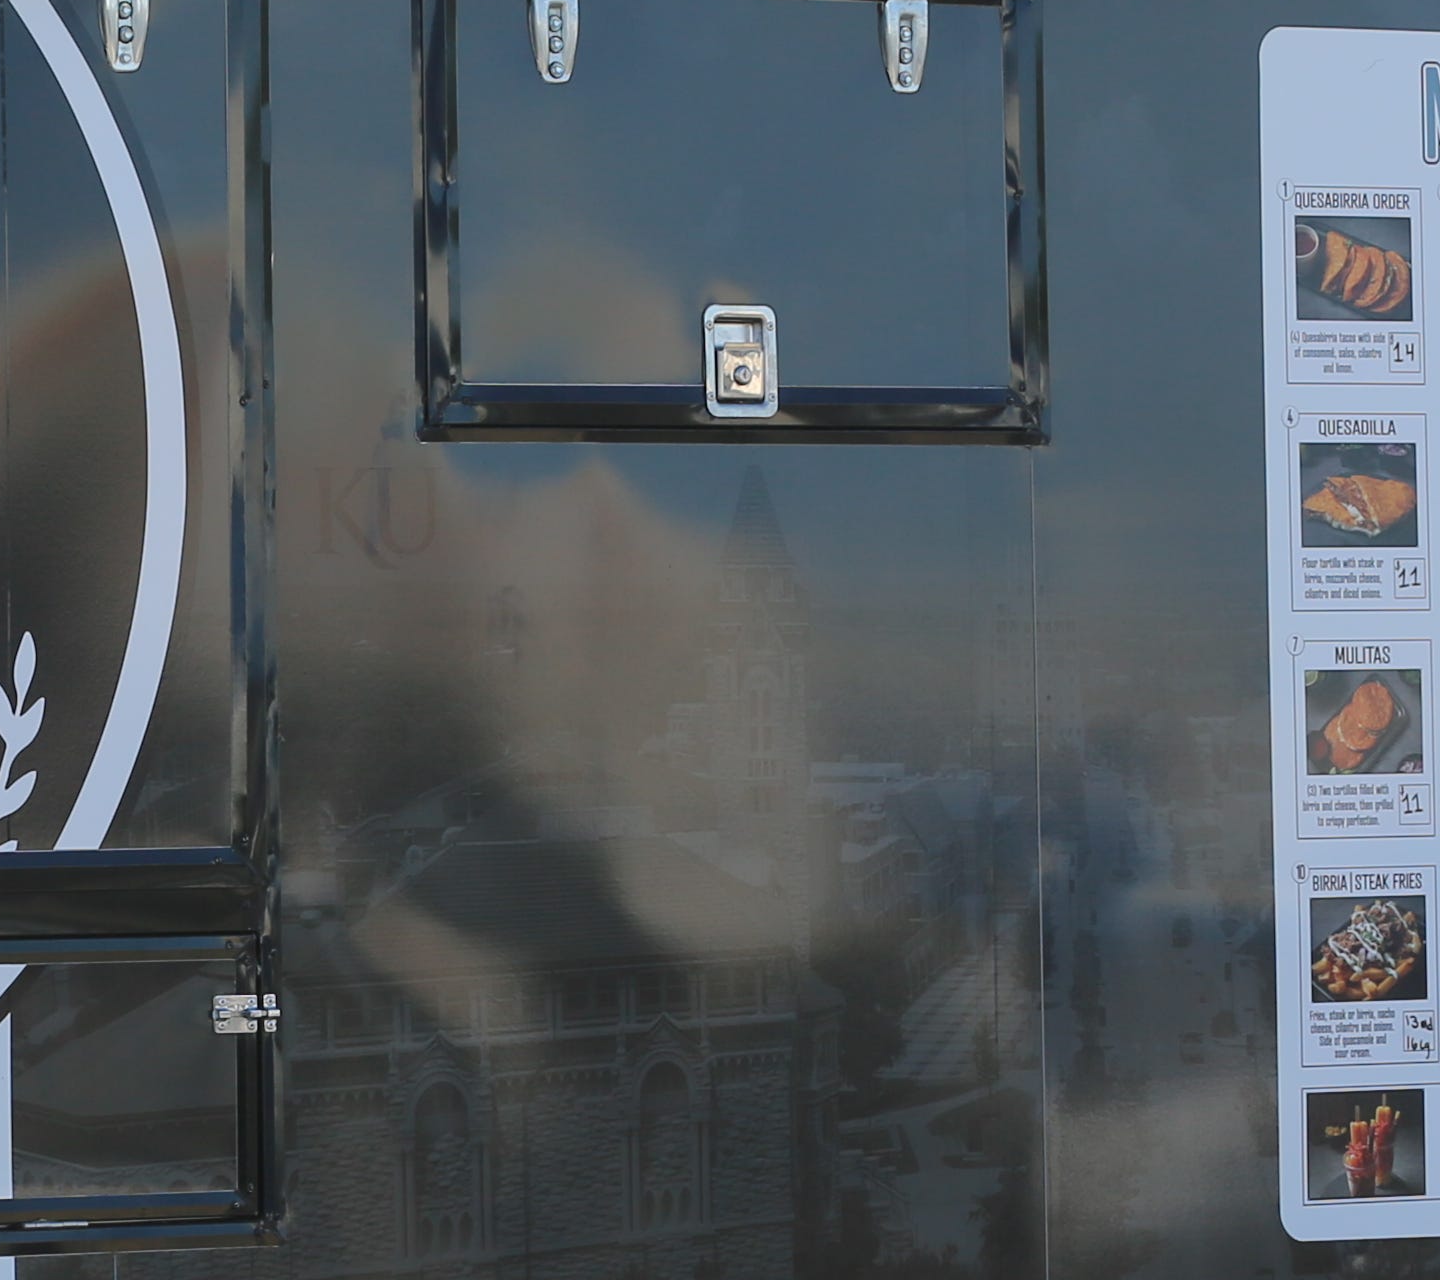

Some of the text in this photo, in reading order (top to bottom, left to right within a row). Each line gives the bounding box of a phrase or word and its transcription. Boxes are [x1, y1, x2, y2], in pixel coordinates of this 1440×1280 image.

[1283, 181, 1287, 197] 1
[1295, 192, 1409, 209] QUESABIRRIA ORDER
[1286, 411, 1293, 423] 4
[1318, 420, 1396, 436] QUESADILLA
[1293, 637, 1298, 652] 7
[1335, 646, 1391, 664] MULITAS
[1393, 873, 1422, 889] FRIES
